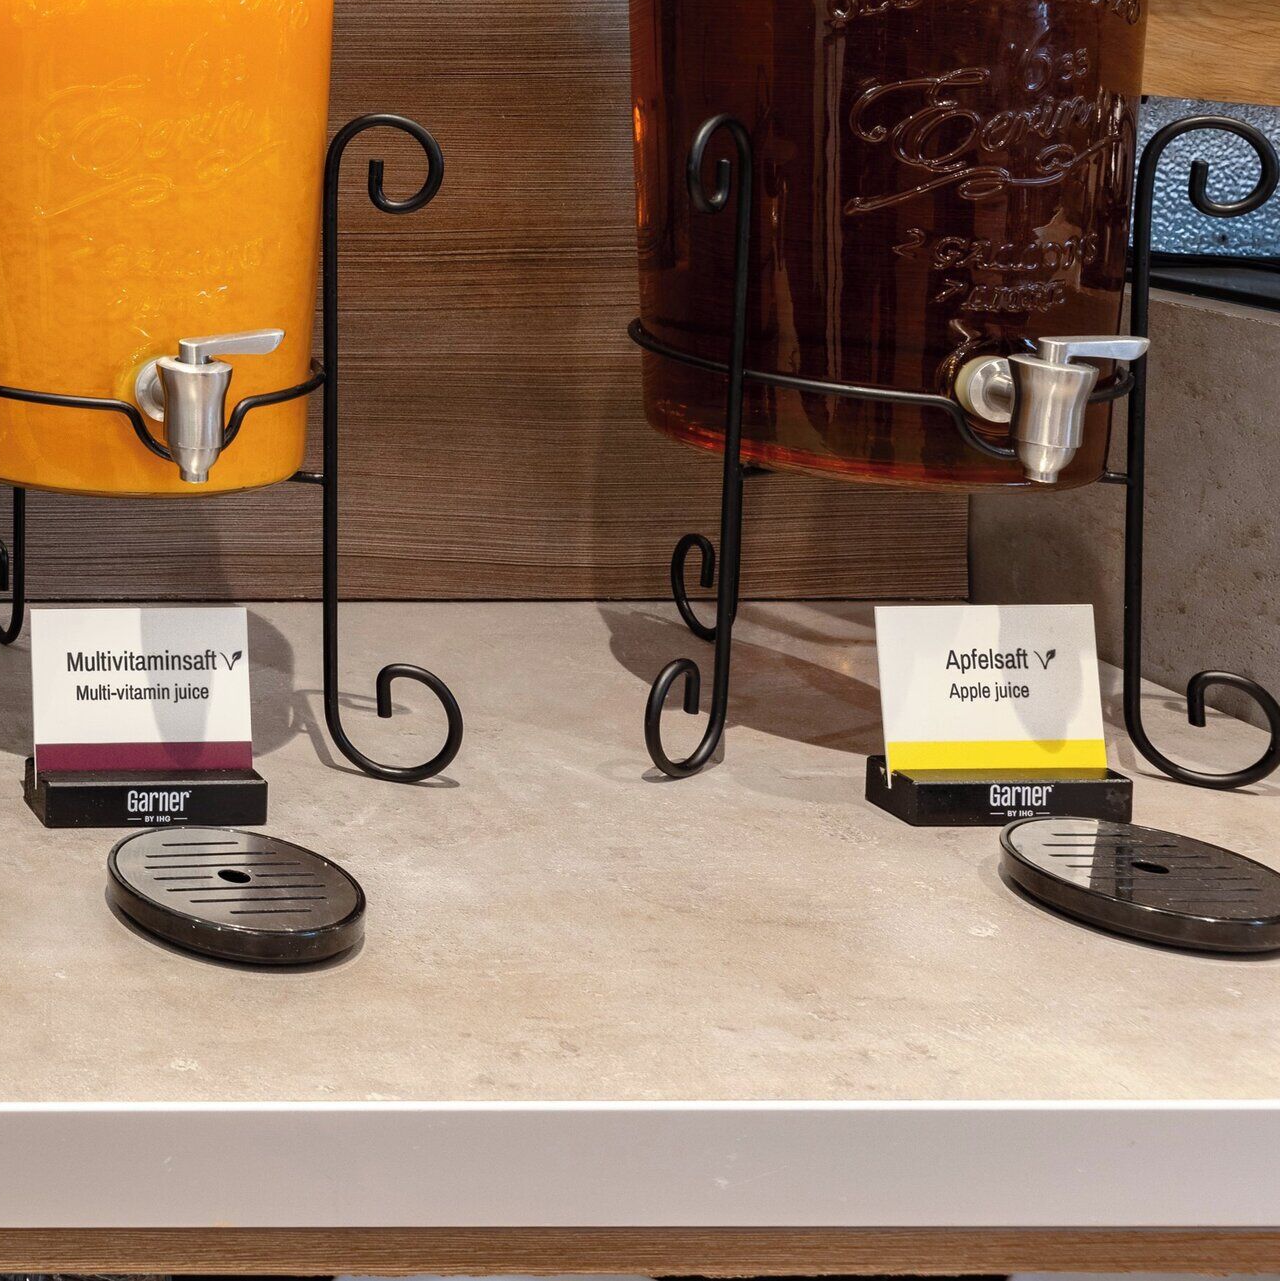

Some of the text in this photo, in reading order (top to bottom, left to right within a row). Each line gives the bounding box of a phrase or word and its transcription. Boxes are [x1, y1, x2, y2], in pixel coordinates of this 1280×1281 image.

[66, 649, 218, 673] Multivitaminsaft
[945, 647, 1029, 675] Apfelsaft
[76, 683, 210, 704] Multi-vitamin juice
[949, 682, 1030, 703] Apple juice
[127, 790, 191, 813] Garner
[989, 785, 1053, 807] Garner
[144, 815, 171, 823] BY IHG
[1006, 809, 1034, 817] BY IHG
